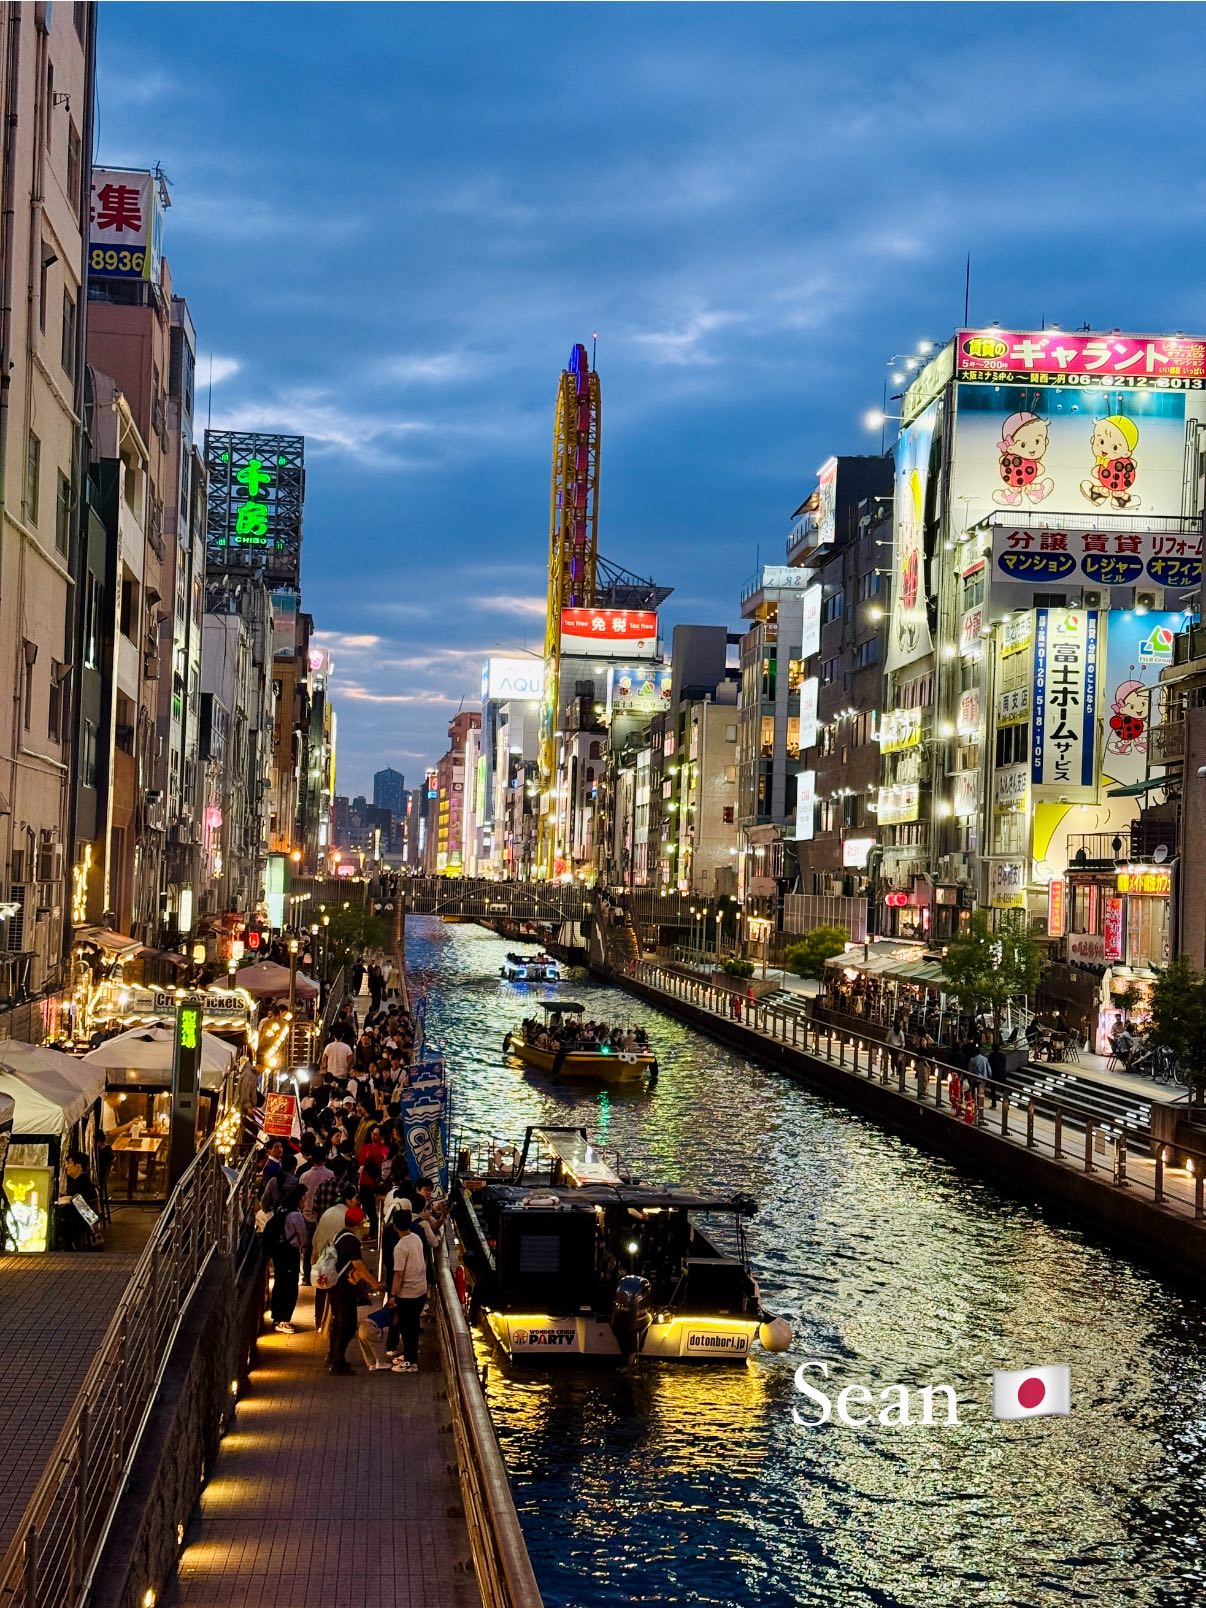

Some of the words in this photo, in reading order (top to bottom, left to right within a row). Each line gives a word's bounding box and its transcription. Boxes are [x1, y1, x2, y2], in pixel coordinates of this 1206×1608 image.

[90, 184, 142, 232] 集
[969, 339, 1006, 358] 賃貸の
[1010, 338, 1170, 373] ギャラント
[236, 458, 271, 536] 千房
[234, 536, 268, 545] CHIBO
[1003, 554, 1073, 573] マンション
[1086, 557, 1142, 575] レジャー
[1101, 573, 1126, 583] ビル
[1167, 576, 1193, 586] ビル
[499, 677, 544, 692] AQU
[1049, 642, 1080, 781] 富士ホームサービス
[156, 993, 198, 1007] Crue
[199, 994, 245, 1009] Tickets
[407, 1125, 447, 1202] CRUIS
[528, 1334, 575, 1345] PARTY
[689, 1334, 746, 1350] dotonbori.jp
